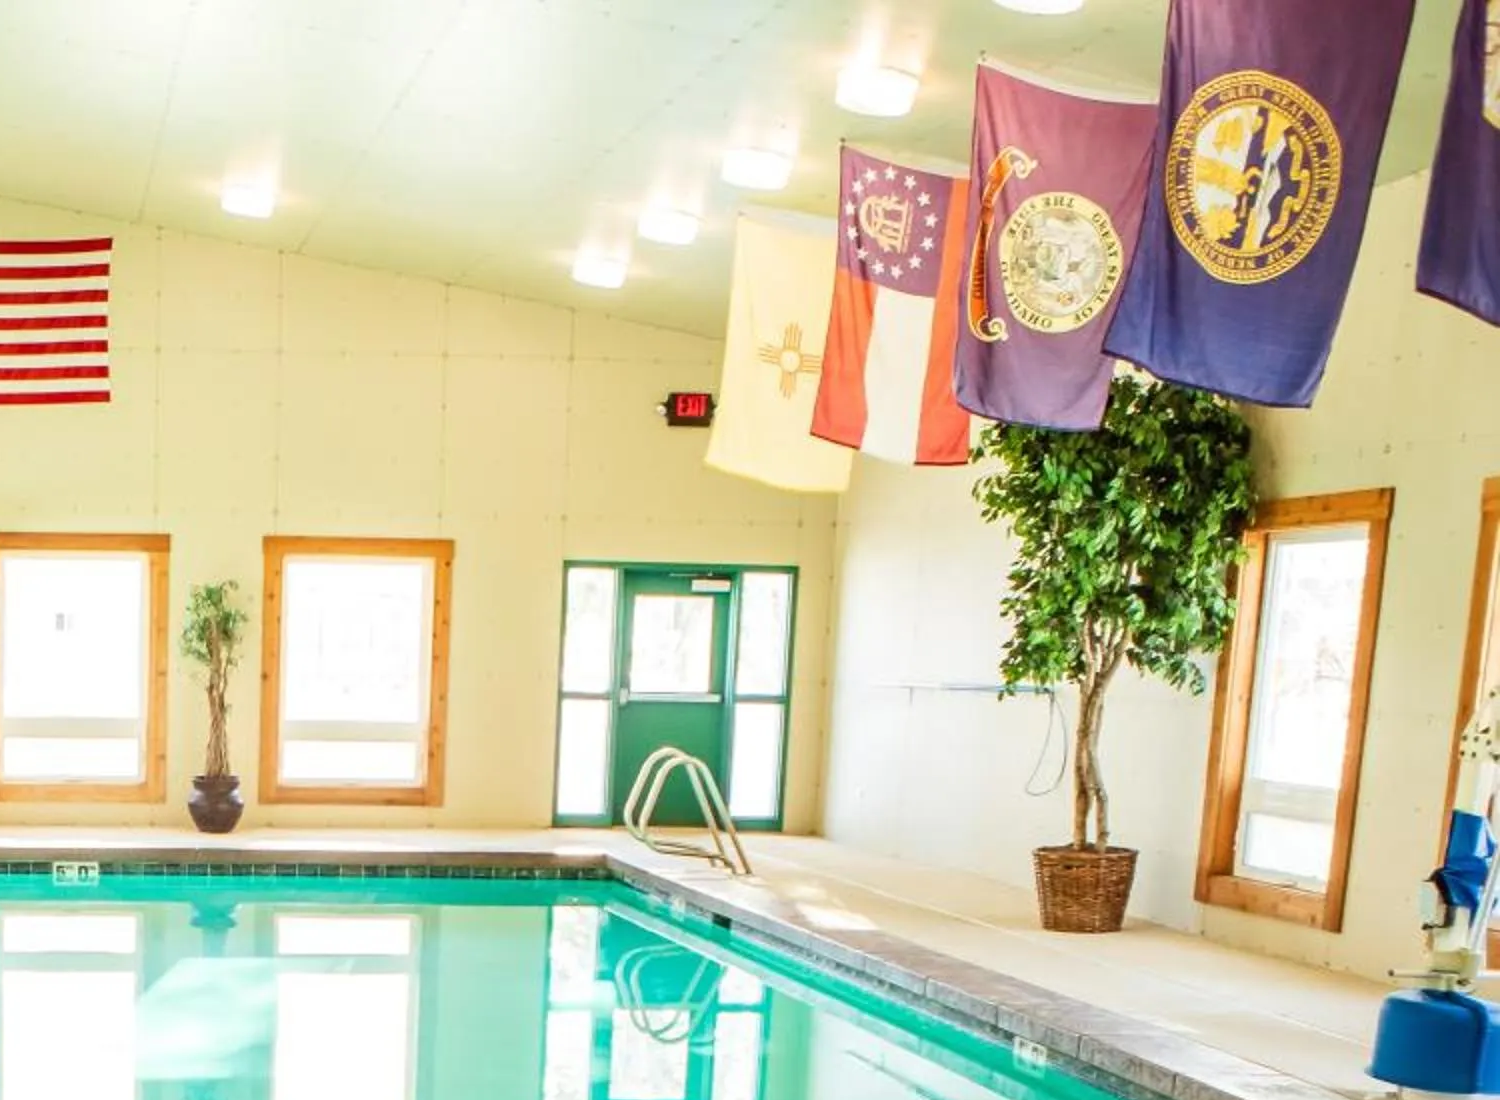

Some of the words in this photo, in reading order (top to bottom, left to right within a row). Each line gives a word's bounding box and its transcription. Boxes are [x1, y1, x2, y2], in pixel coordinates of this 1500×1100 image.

[1220, 85, 1265, 101] GREAT
[1042, 196, 1075, 208] THE
[1091, 212, 1119, 258] GREAT
[1099, 264, 1118, 304] SEAL
[1007, 291, 1052, 329] IDAHO
[1073, 306, 1093, 325] OF
[676, 394, 708, 416] EXIT
